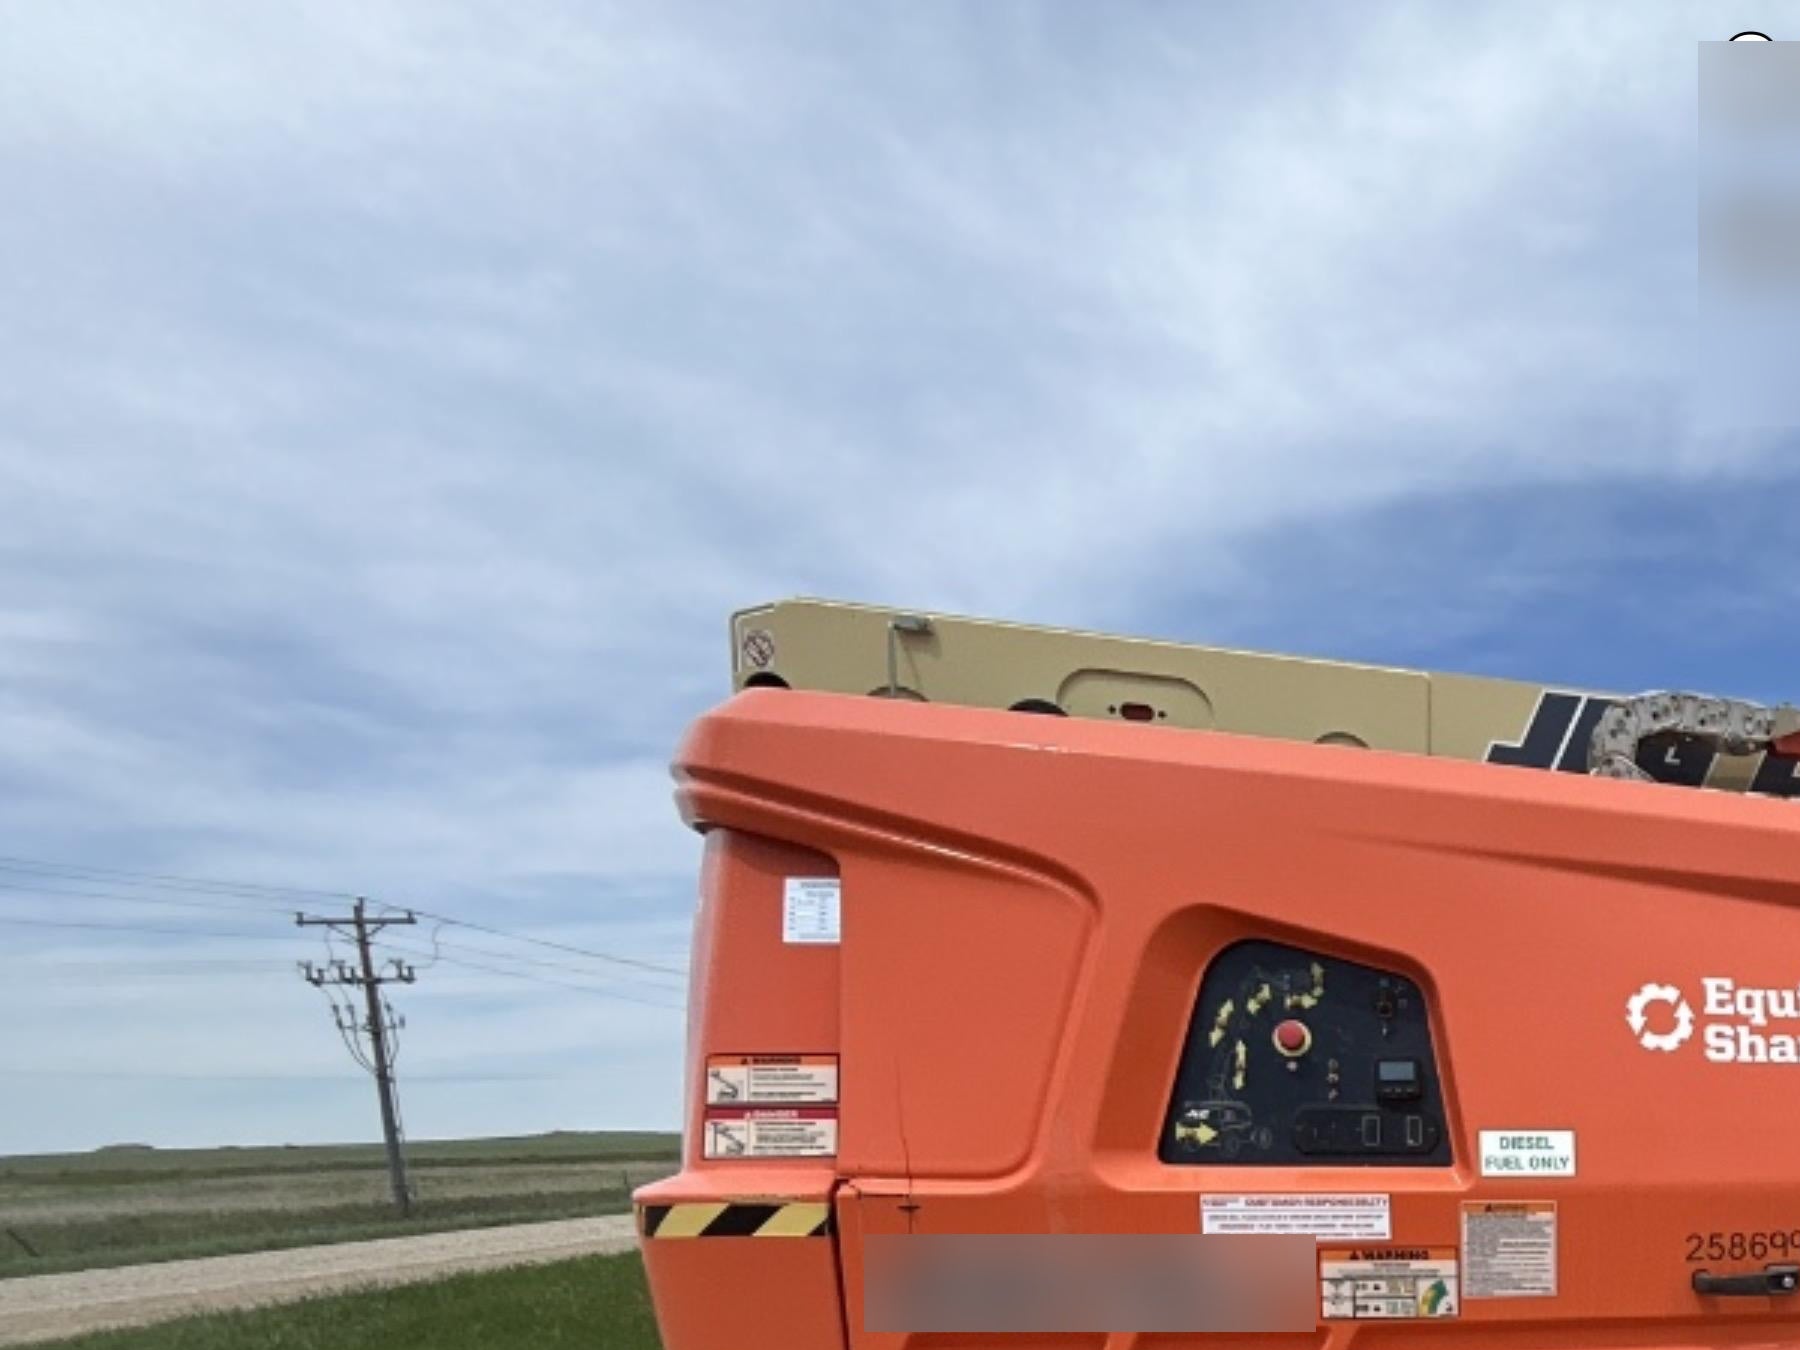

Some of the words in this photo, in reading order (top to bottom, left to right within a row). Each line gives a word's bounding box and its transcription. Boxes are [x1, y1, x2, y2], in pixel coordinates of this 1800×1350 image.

[1499, 1136, 1554, 1150] DIESEL
[1485, 1155, 1524, 1170] FUEL
[1529, 1155, 1569, 1170] ONLY
